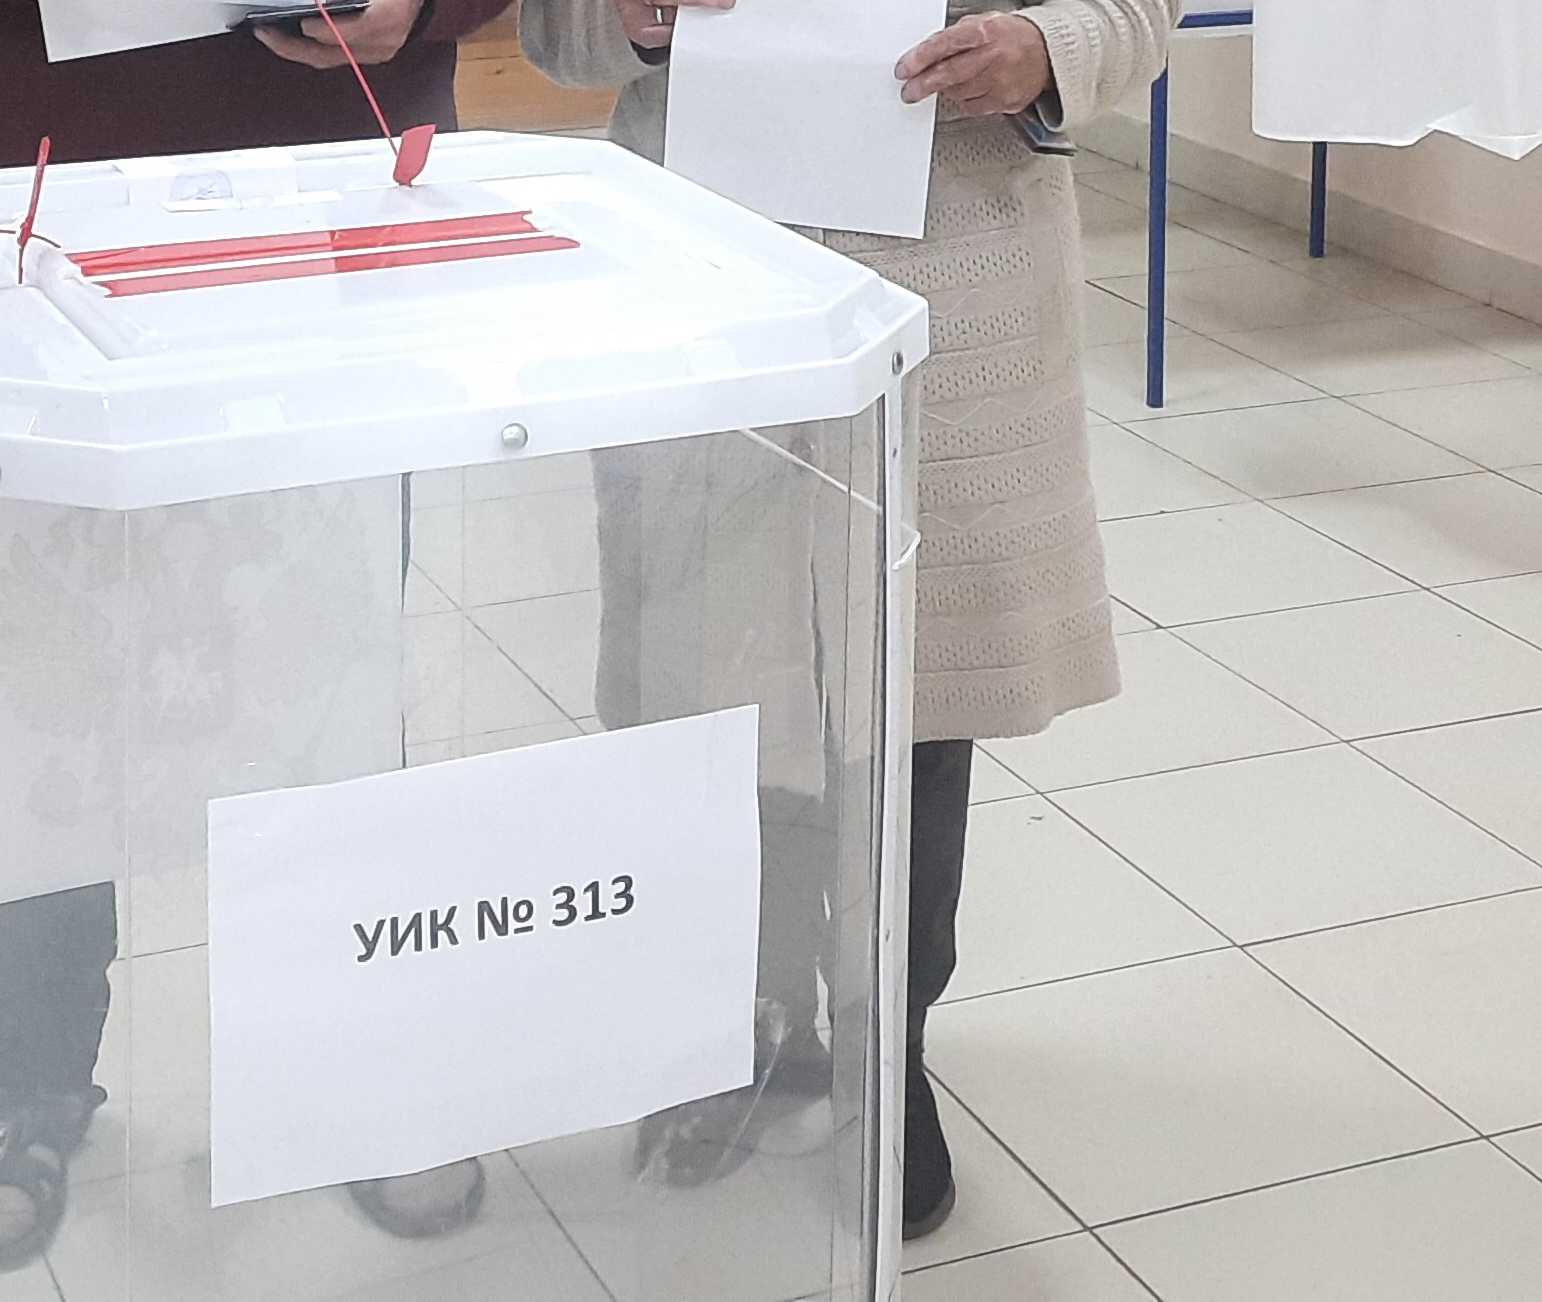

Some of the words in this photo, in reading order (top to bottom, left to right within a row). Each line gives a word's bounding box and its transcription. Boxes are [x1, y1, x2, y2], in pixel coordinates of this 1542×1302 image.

[353, 905, 459, 962] УИК
[477, 896, 534, 941] №
[551, 875, 635, 926] 313
